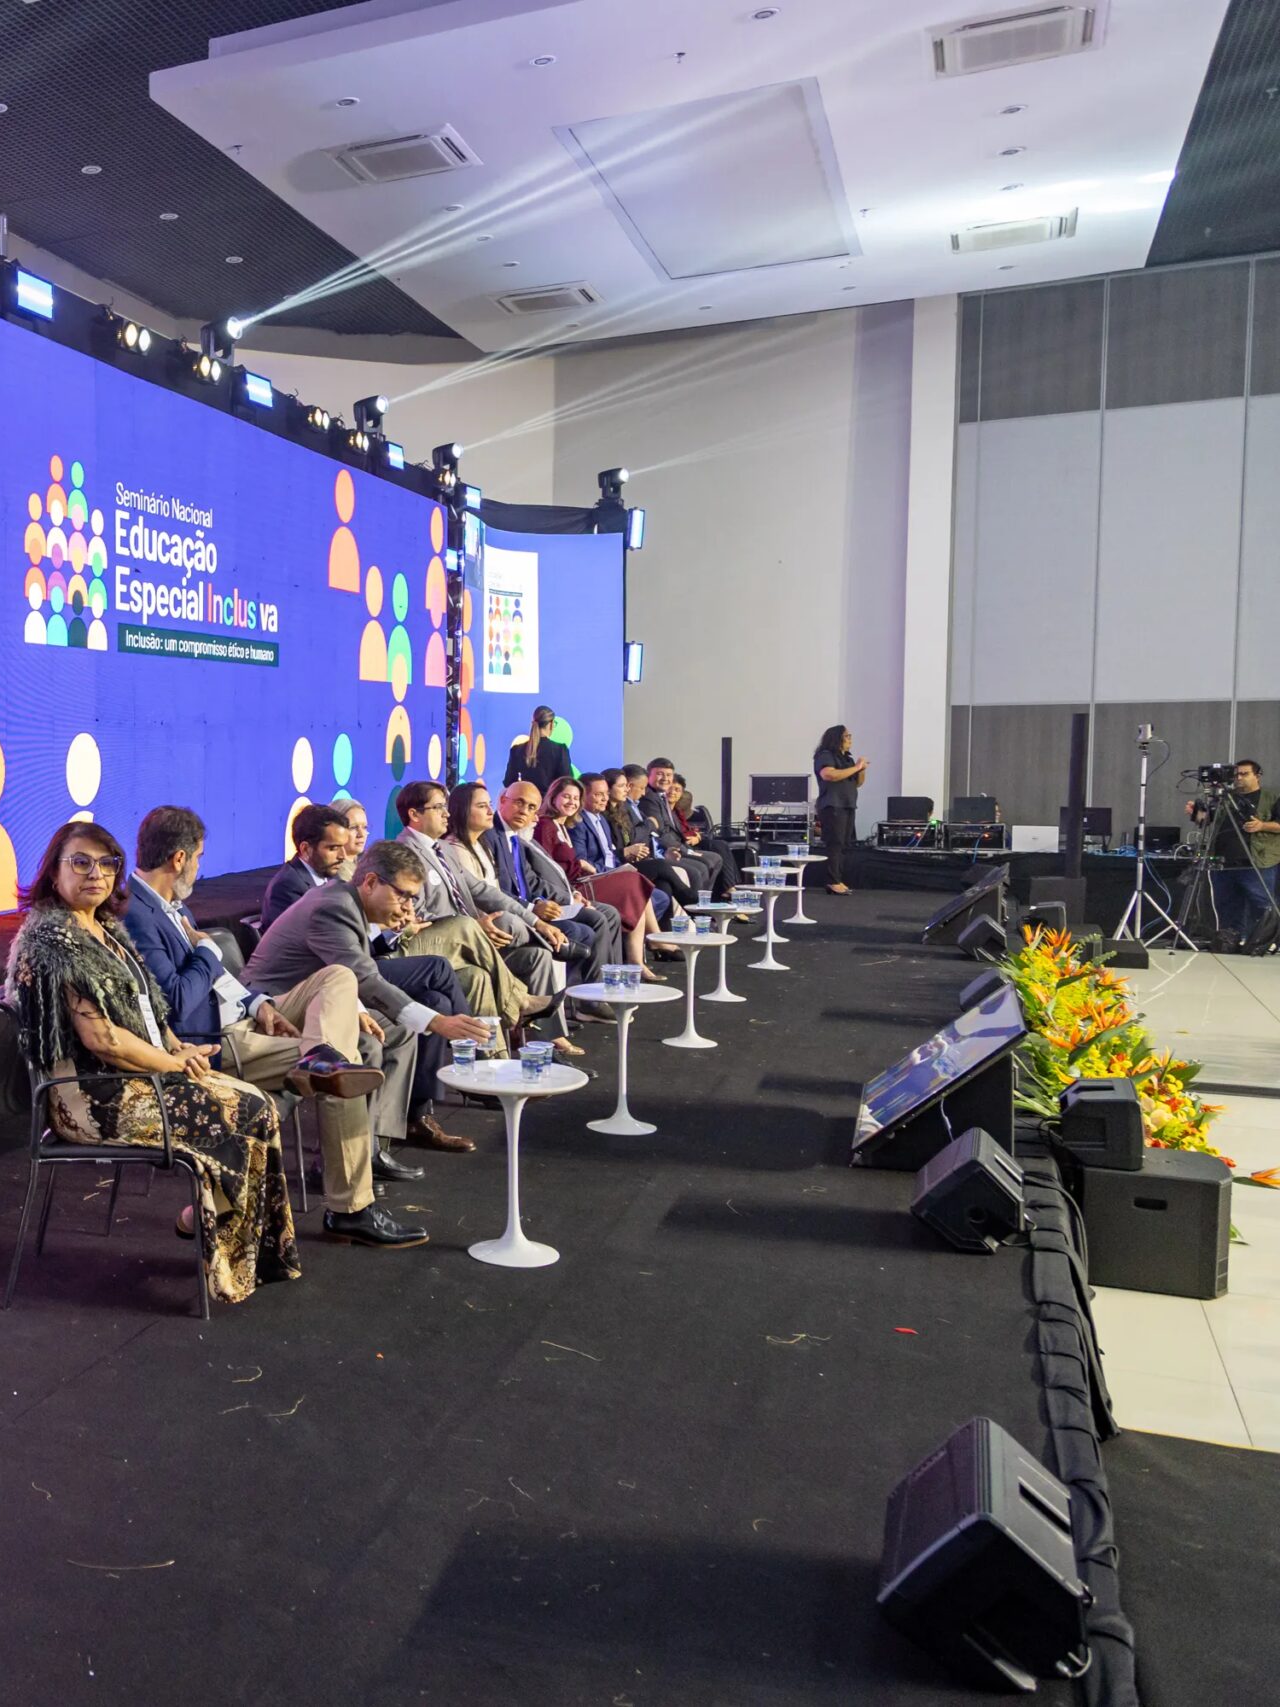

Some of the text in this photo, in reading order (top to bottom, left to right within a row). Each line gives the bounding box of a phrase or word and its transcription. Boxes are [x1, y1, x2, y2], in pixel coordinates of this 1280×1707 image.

[115, 481, 213, 529] Seminário Nacional
[115, 509, 218, 578] Educação
[115, 565, 204, 625] Especial
[125, 630, 163, 650] Inclusão:
[164, 638, 178, 652] um
[178, 639, 227, 658] compromisso
[228, 642, 244, 659] ético
[250, 644, 274, 662] humano
